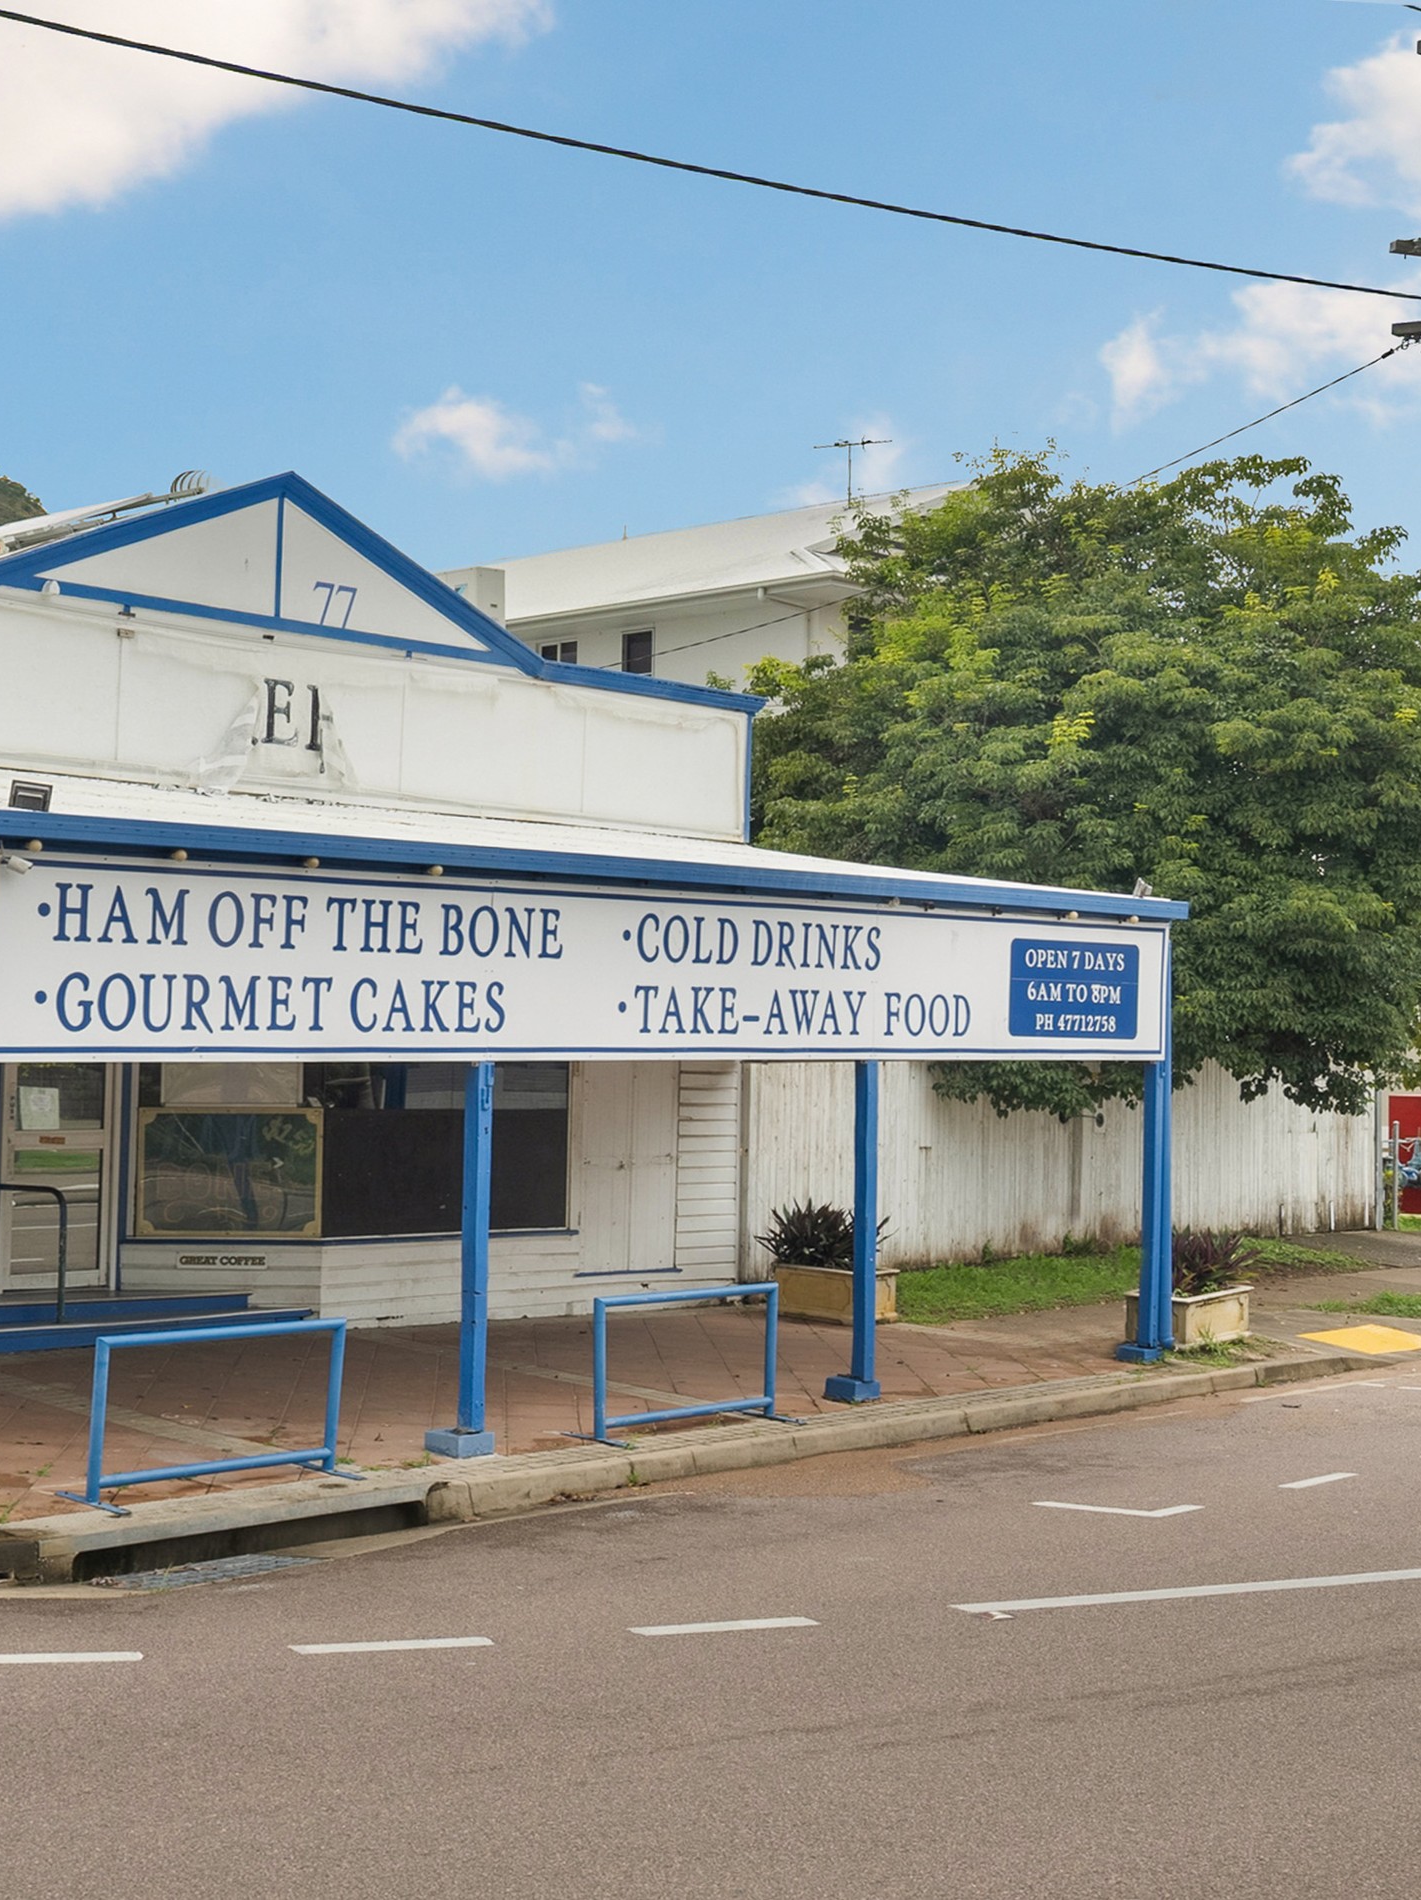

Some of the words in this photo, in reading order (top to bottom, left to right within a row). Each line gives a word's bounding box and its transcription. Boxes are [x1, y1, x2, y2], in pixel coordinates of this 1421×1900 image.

[313, 581, 358, 628] 77
[53, 882, 190, 945] HAM
[208, 891, 308, 949] OFF
[326, 896, 423, 954] THE
[439, 903, 563, 959] BONE
[636, 912, 739, 965] COLD
[751, 919, 881, 972] DRINKS
[1025, 949, 1068, 968] OPEN
[1072, 951, 1081, 969] 7
[1084, 951, 1125, 971] DAYS
[55, 971, 334, 1033] GOURMET
[350, 977, 506, 1033] CAKES
[634, 984, 867, 1036] TAKE-AWAY
[883, 992, 971, 1037] FOOD
[1027, 981, 1062, 1001] 6AM
[1066, 984, 1088, 1002] TO
[1035, 1014, 1054, 1030] PH
[1057, 1014, 1117, 1032] 47712758
[180, 1255, 217, 1266] GREAT
[219, 1255, 266, 1267] COFFEE
